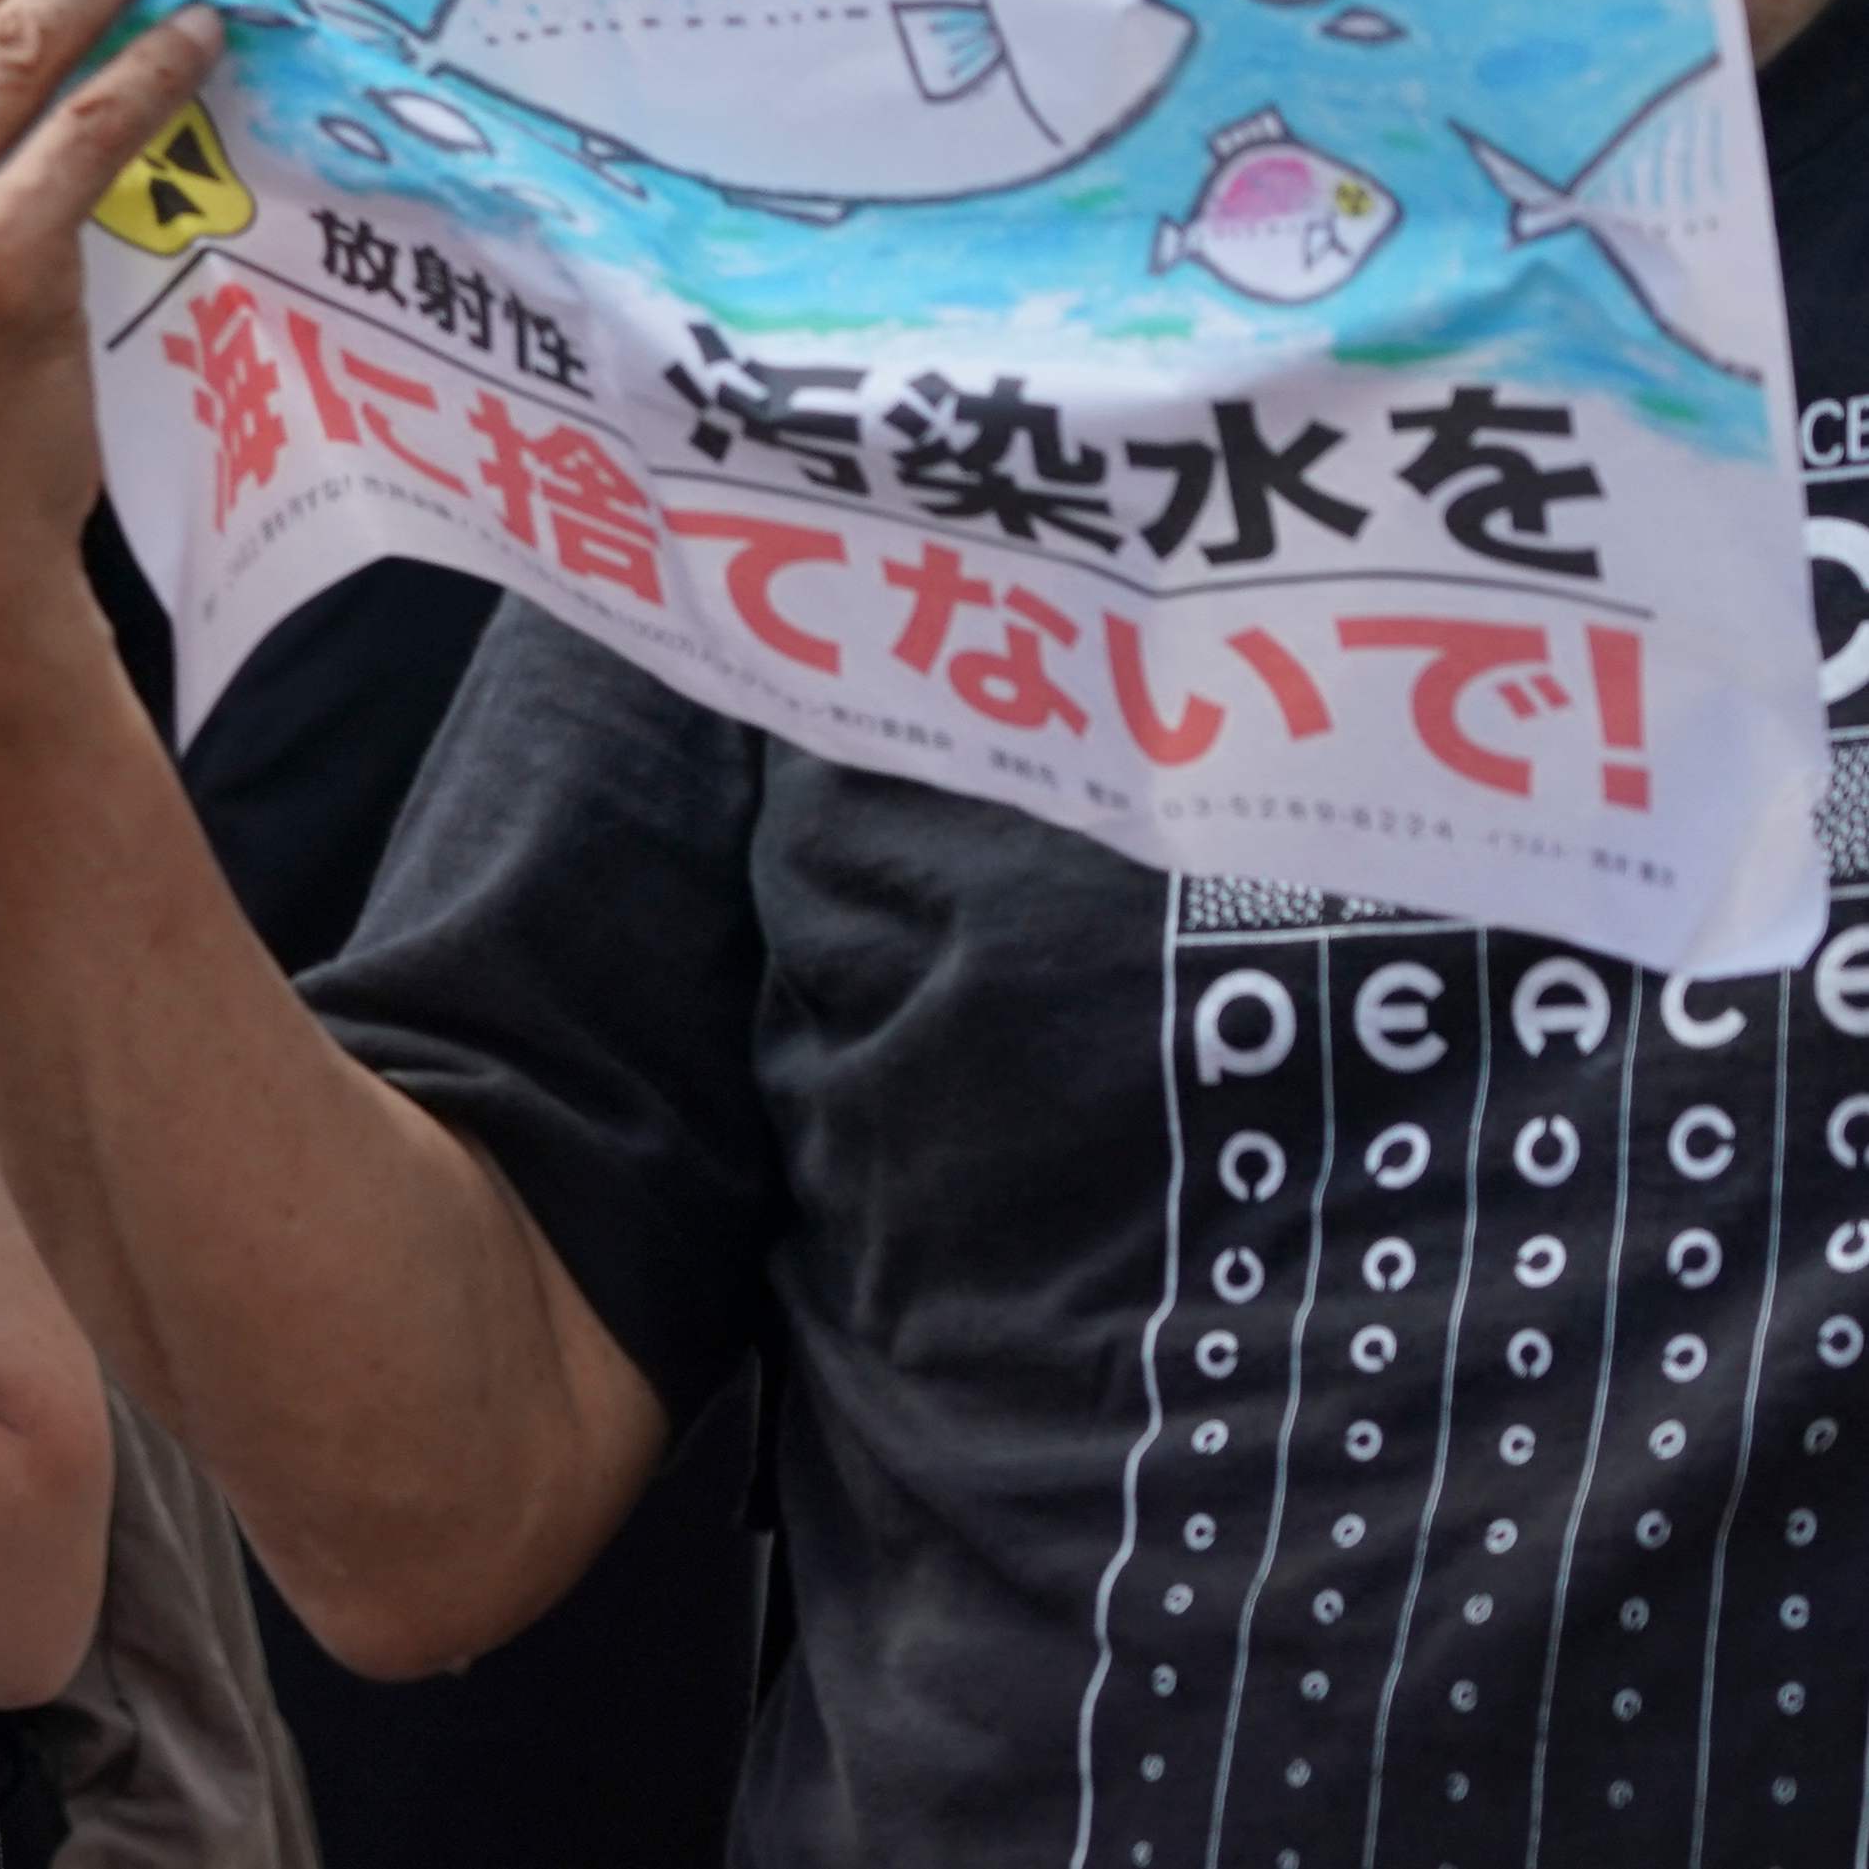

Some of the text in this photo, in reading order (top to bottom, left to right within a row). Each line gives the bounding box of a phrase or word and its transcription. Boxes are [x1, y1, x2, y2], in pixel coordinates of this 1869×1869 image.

[309, 207, 595, 403] 放射性
[665, 323, 1604, 580] 汚染水を
